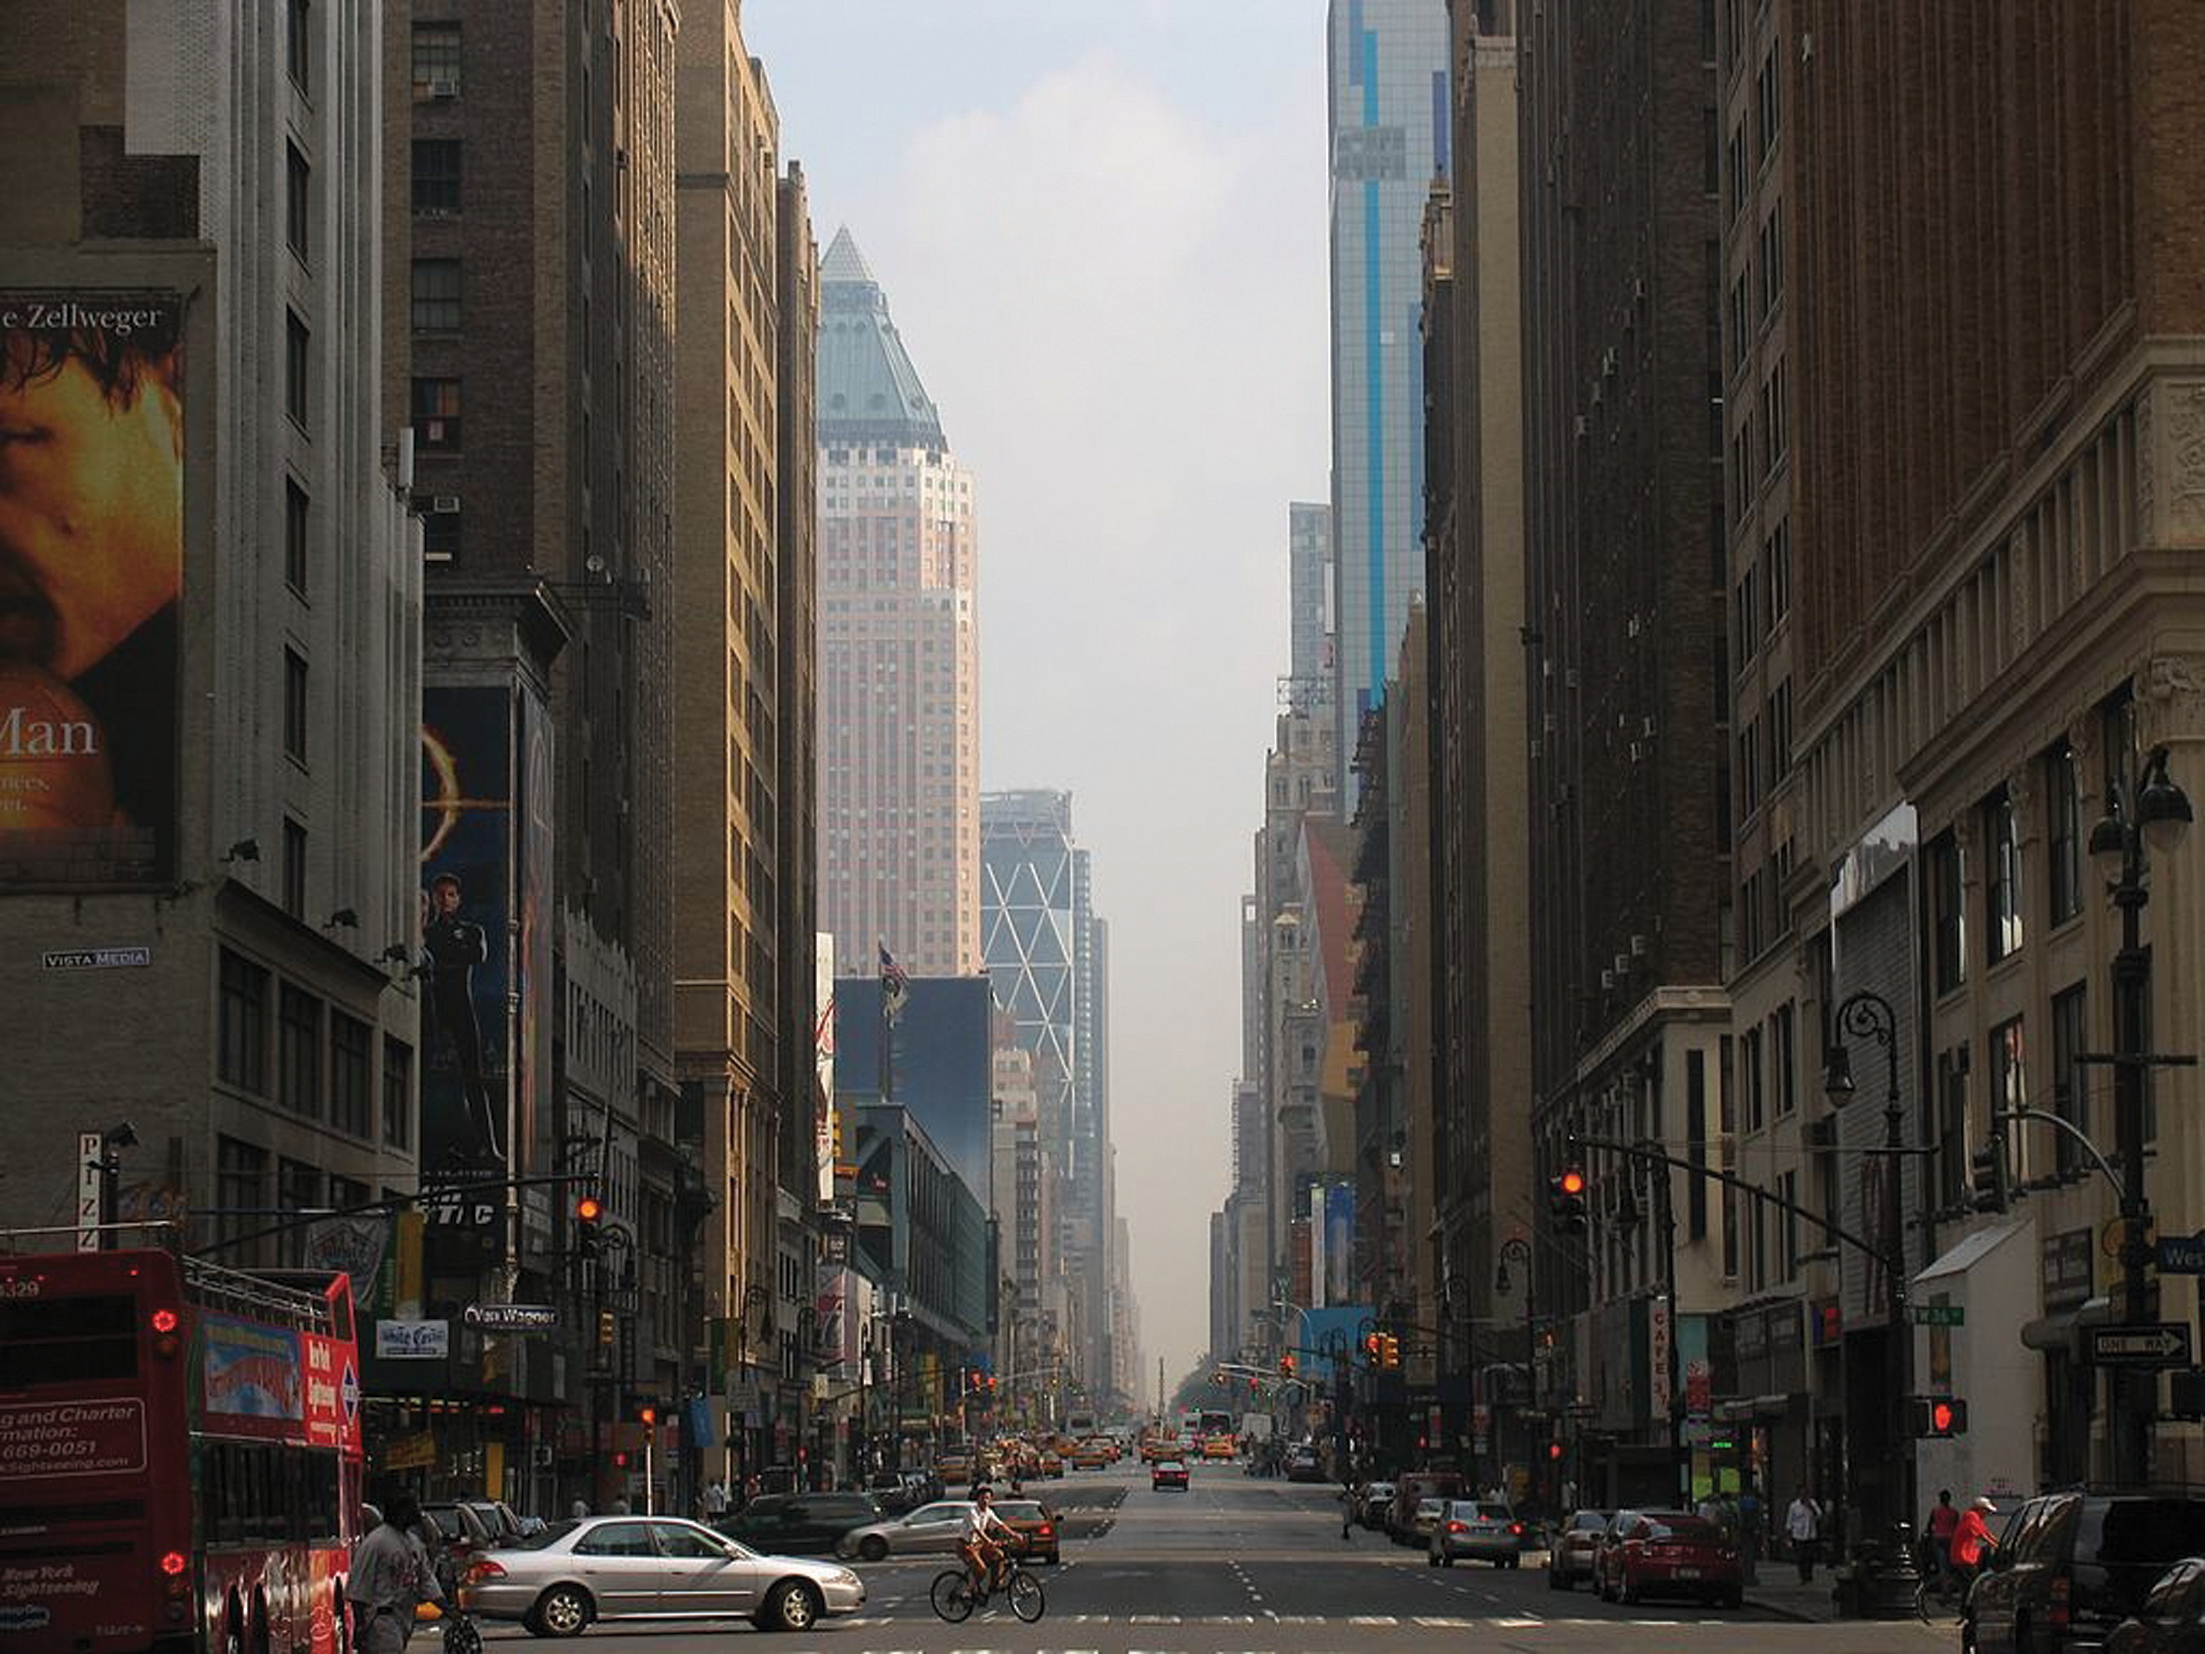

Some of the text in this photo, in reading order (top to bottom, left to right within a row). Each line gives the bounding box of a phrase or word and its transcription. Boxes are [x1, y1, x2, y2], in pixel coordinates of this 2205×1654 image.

[27, 303, 164, 336] Zellweger
[96, 952, 144, 965] MEDIA
[503, 1308, 556, 1324] Wagner
[1654, 1313, 1666, 1375] CAFE
[18, 1409, 55, 1424] and
[59, 1406, 135, 1423] Charter
[3, 1440, 96, 1459] 669-0051
